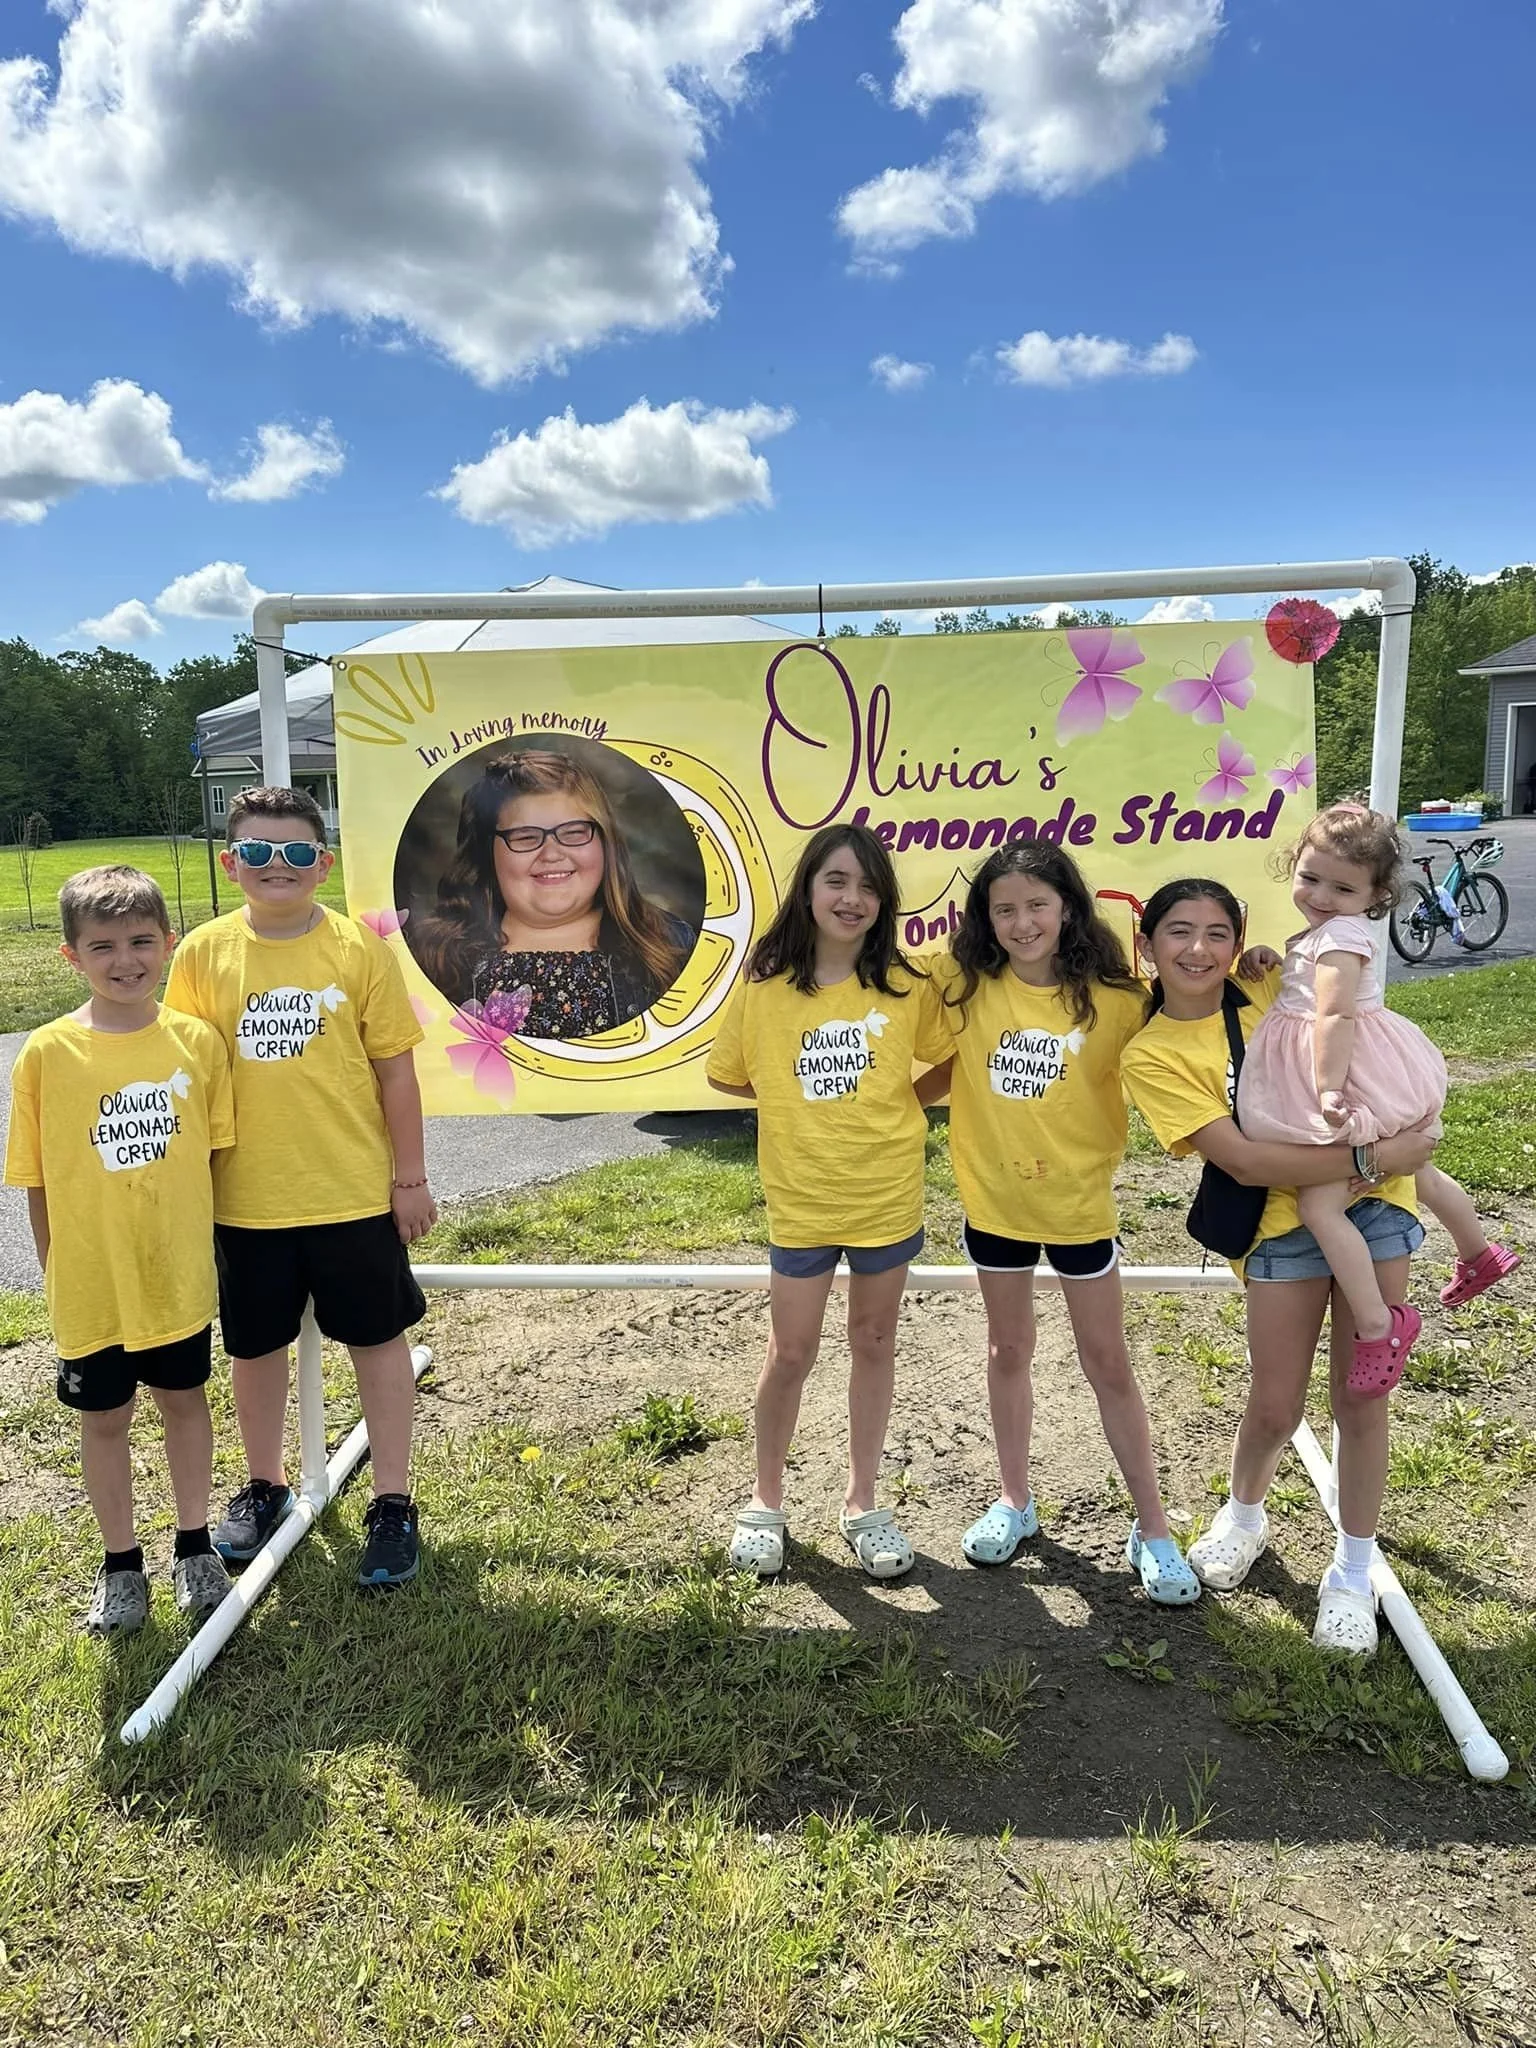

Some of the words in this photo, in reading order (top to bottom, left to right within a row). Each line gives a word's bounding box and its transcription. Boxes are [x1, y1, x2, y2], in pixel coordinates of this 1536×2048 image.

[415, 745, 448, 769] In
[450, 716, 516, 754] Loving
[521, 711, 609, 741] memory
[762, 643, 1067, 829] Olivia's
[1112, 788, 1285, 844] Stand
[247, 991, 313, 1014] Olivia's
[255, 1039, 304, 1059] CREW
[801, 1026, 862, 1052] Olivia's
[1000, 1029, 1060, 1060] Olivia's
[793, 1050, 877, 1078] LEMONADE
[986, 1051, 1069, 1082] LEMONADE
[813, 1075, 859, 1098] CREW
[1002, 1076, 1046, 1099] CREW
[100, 1089, 168, 1117] Olivia's
[89, 1115, 182, 1146] LEMONADE
[116, 1140, 168, 1165] CREW
